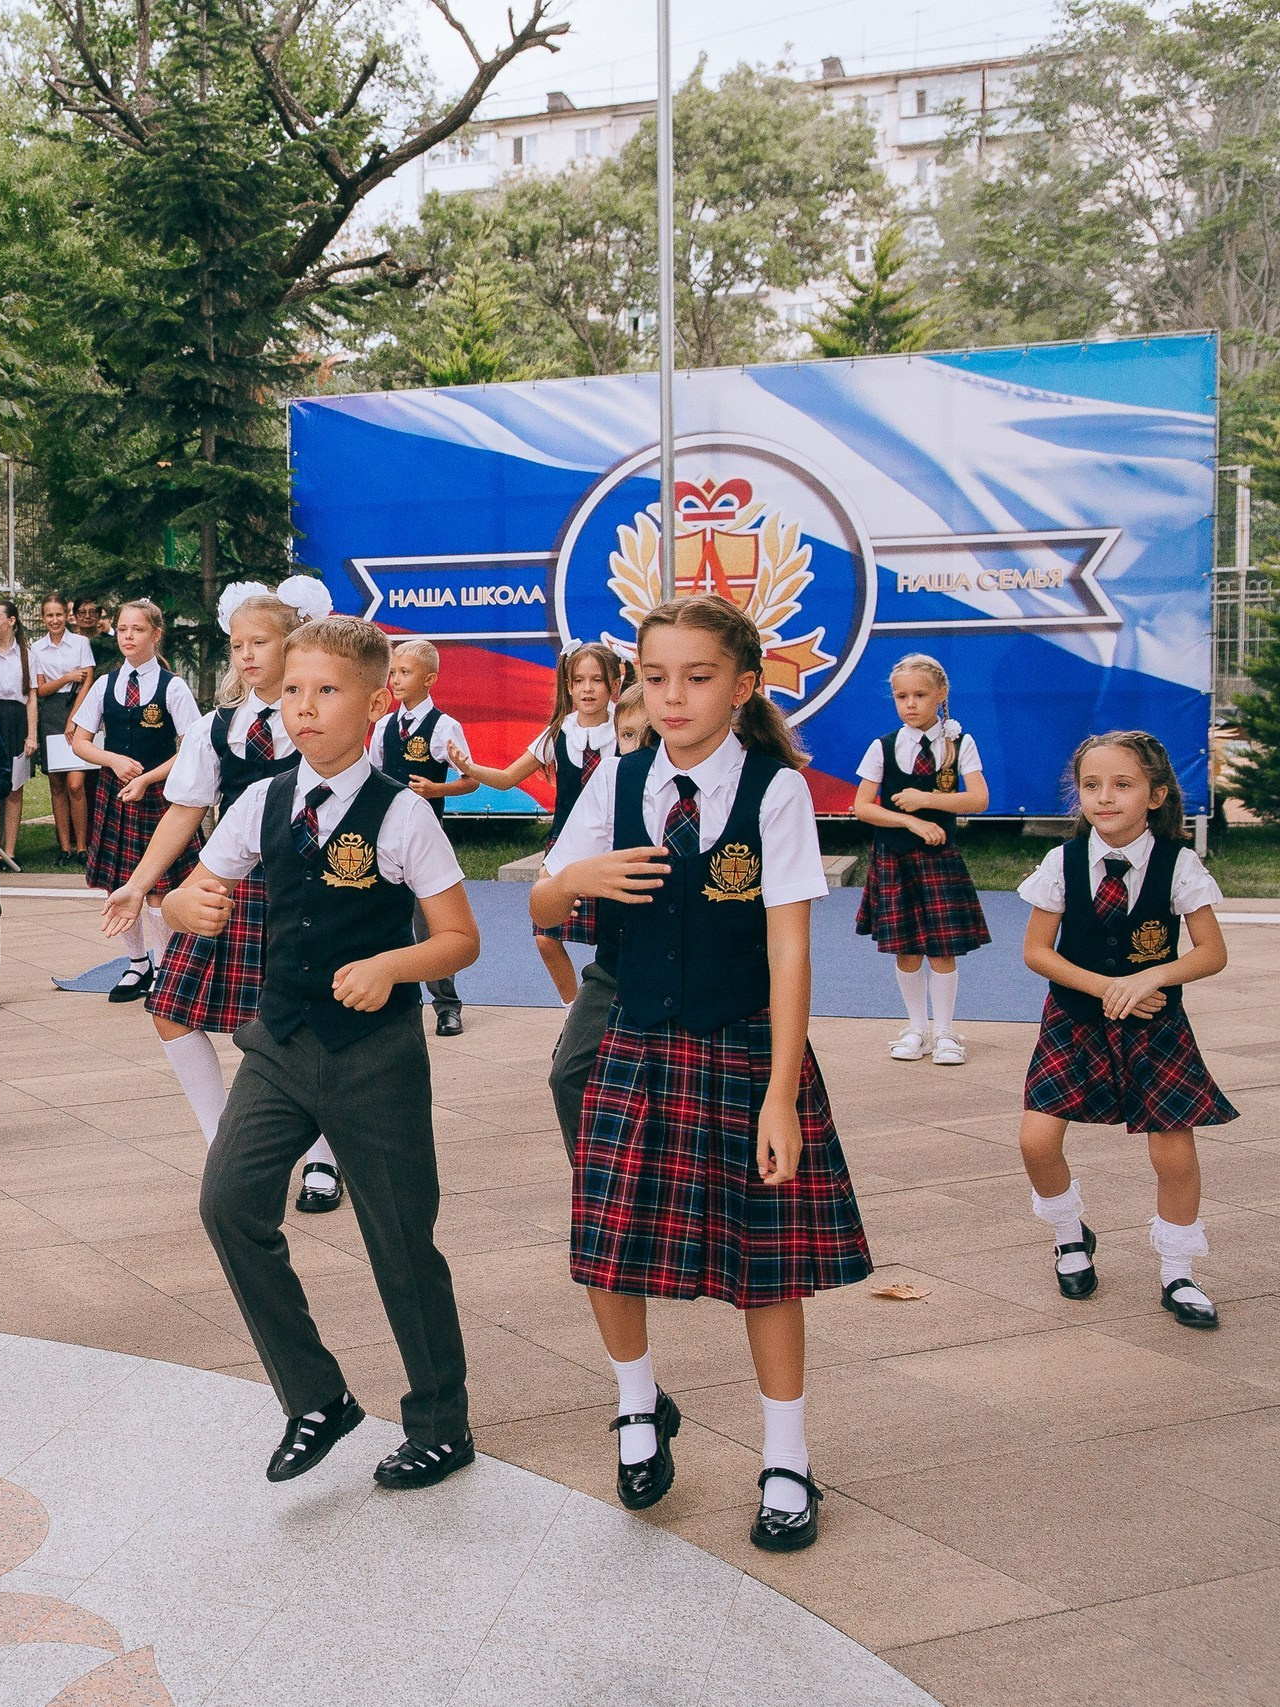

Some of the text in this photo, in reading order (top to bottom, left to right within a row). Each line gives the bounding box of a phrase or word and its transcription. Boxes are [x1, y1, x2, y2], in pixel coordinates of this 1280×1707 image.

[897, 568, 1064, 593] НАША СЕМЬЯ
[389, 585, 546, 608] НАША ШКОЛА
